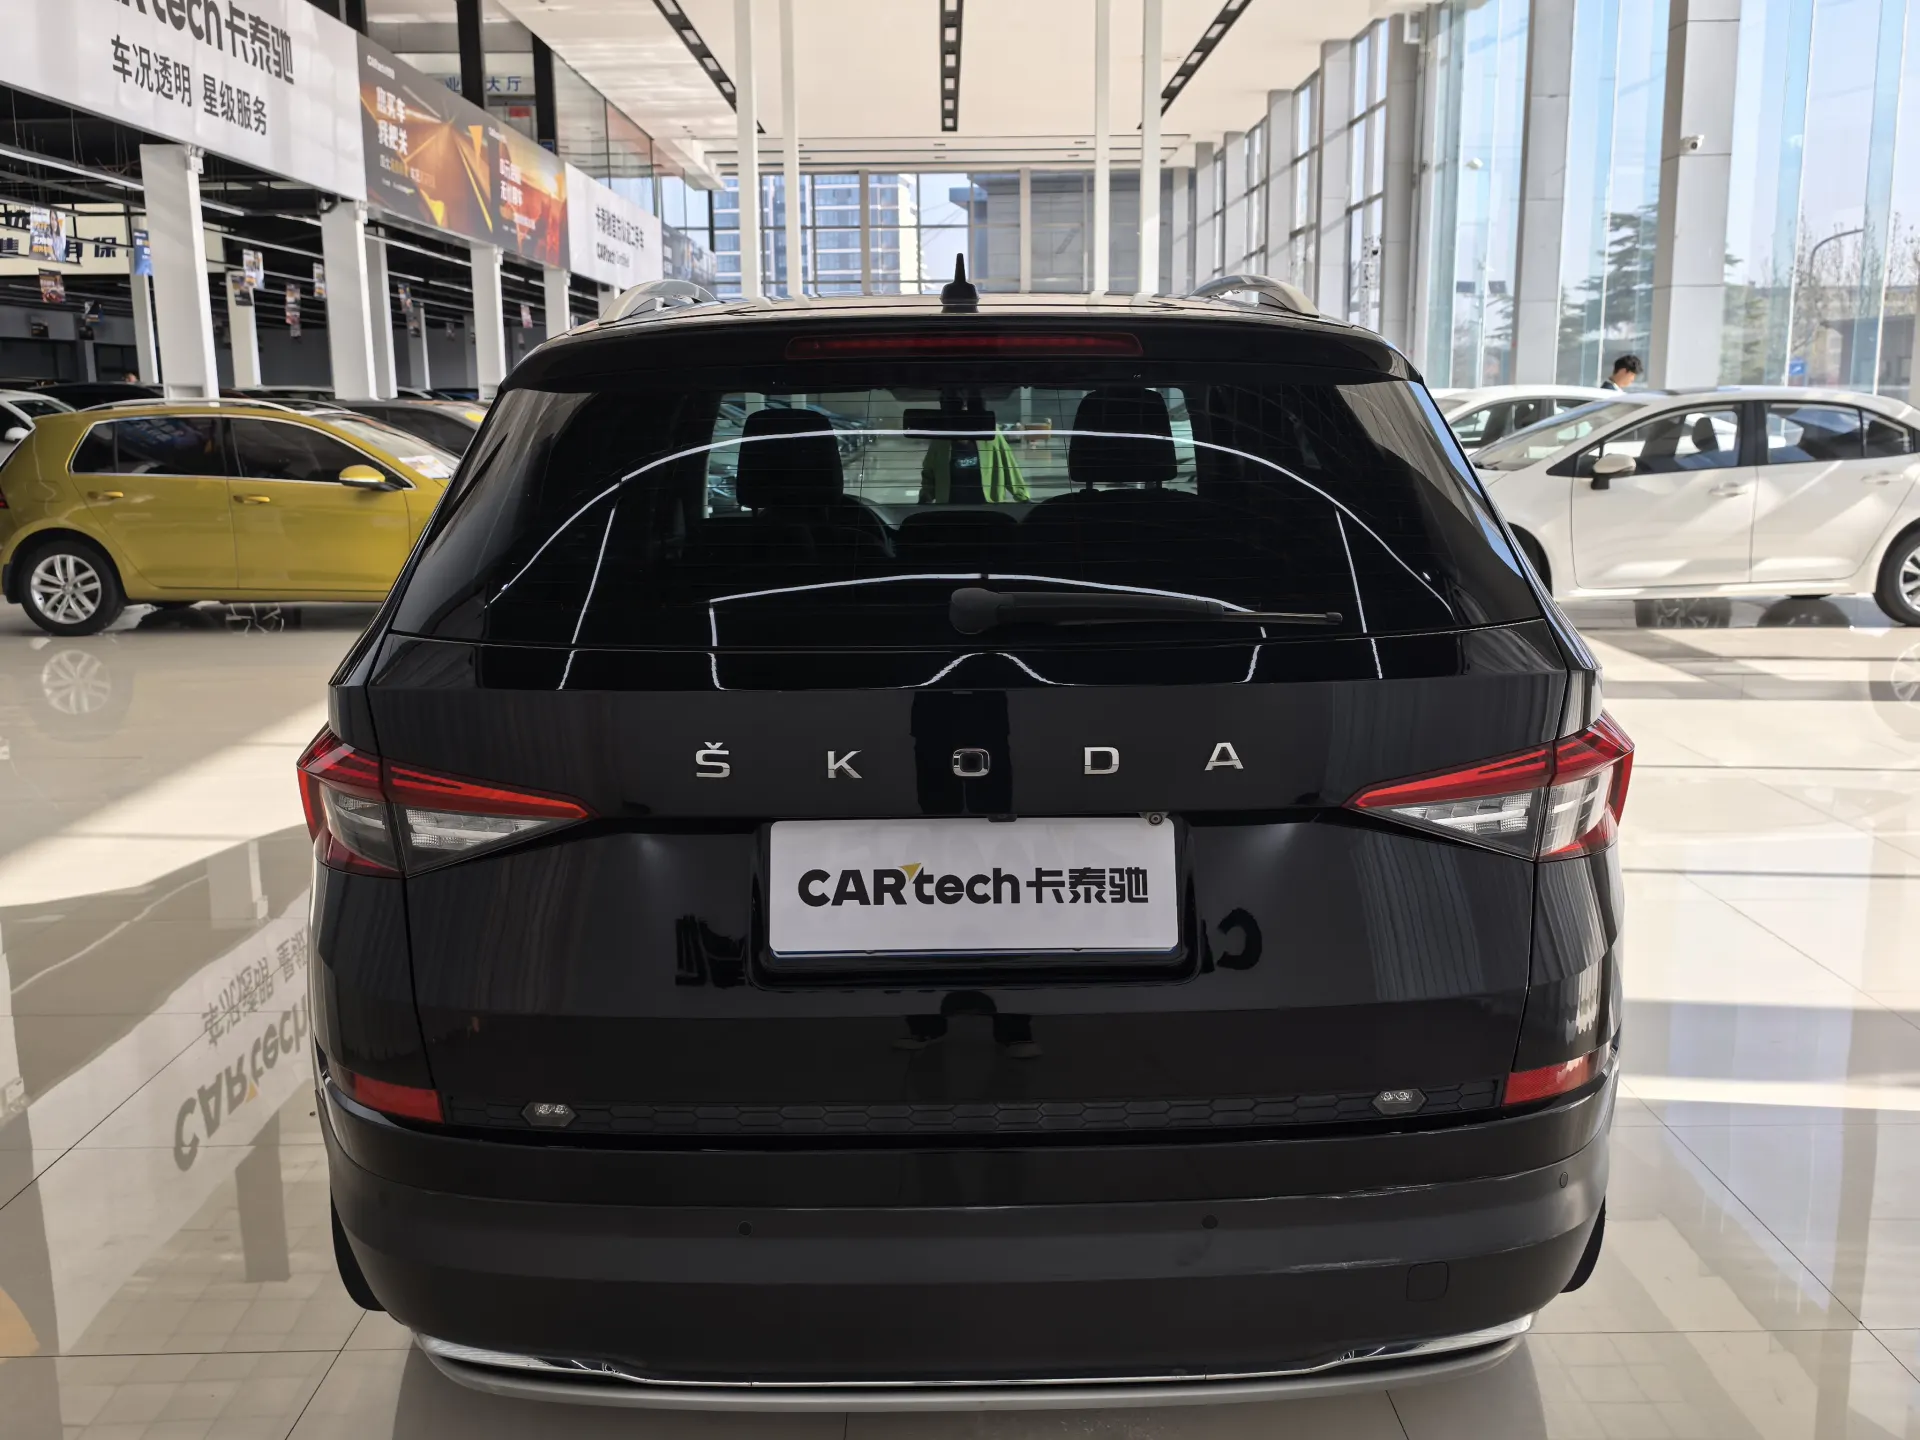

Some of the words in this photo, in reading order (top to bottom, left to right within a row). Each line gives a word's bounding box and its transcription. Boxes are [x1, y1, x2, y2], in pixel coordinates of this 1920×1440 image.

[225, 1, 294, 85] 卡泰驰
[111, 34, 192, 107] 车况透明
[203, 73, 267, 135] 星级服务
[695, 741, 1244, 779] ŠKODA
[797, 865, 1020, 907] CARtech
[1026, 867, 1148, 904] 卡泰驰
